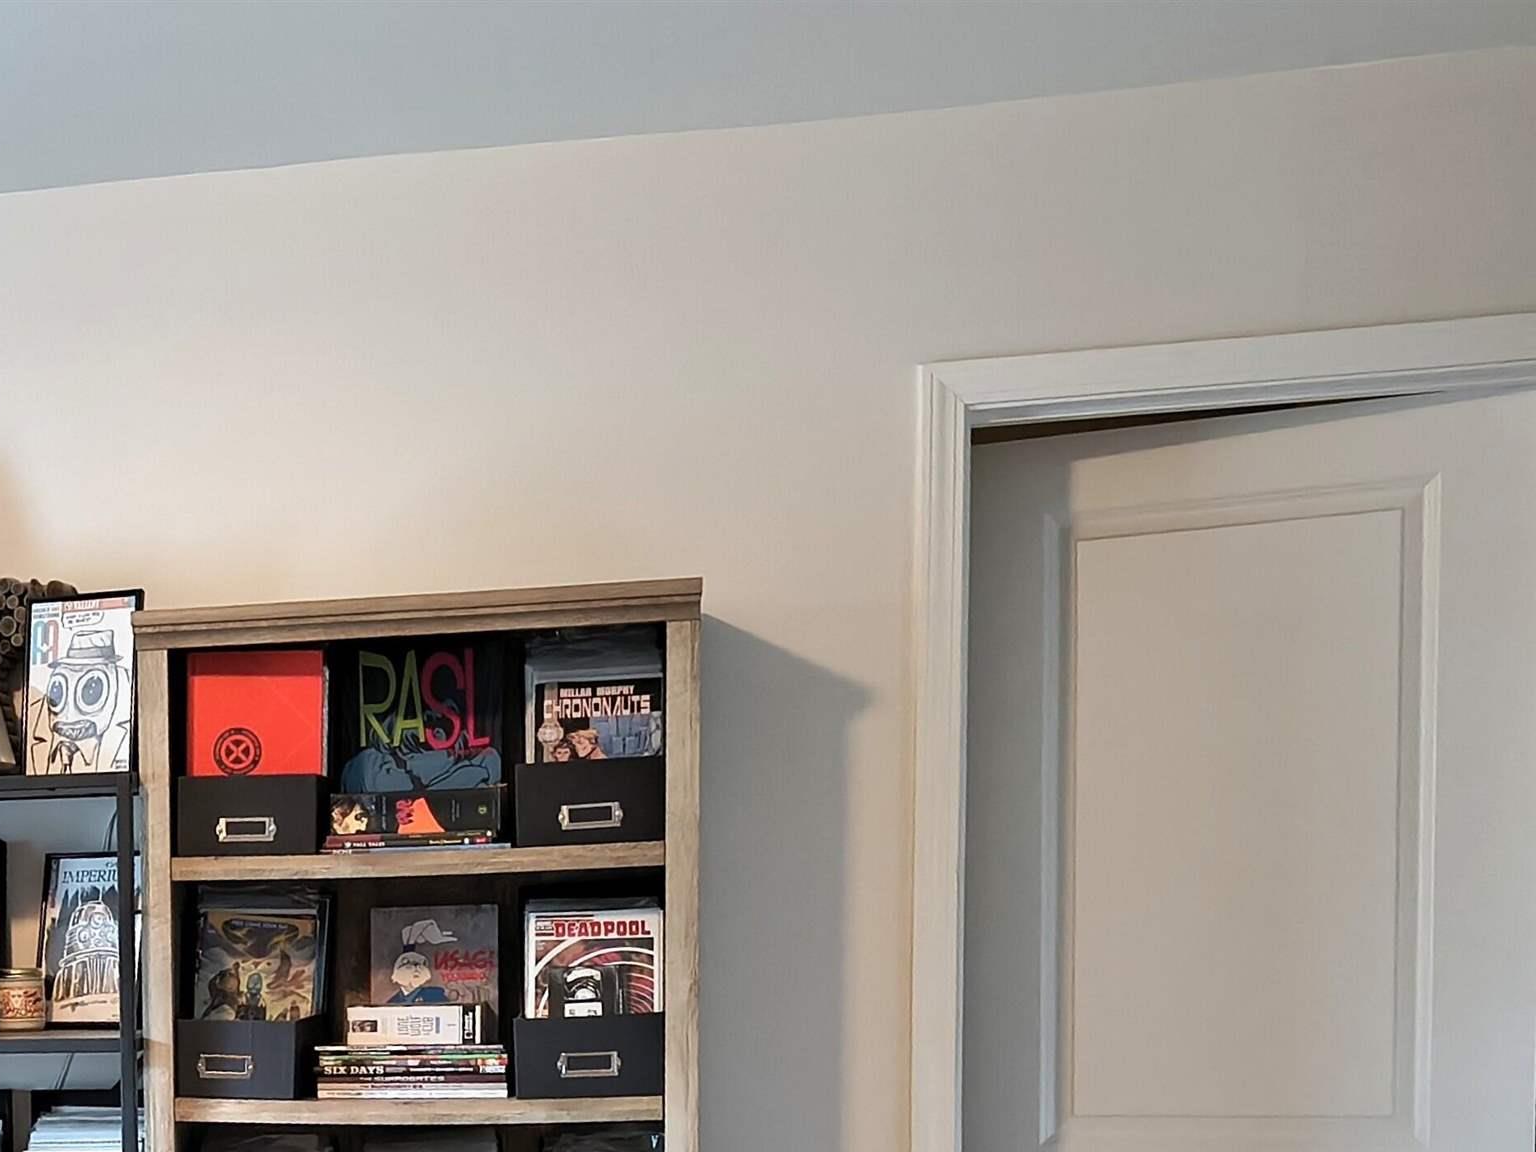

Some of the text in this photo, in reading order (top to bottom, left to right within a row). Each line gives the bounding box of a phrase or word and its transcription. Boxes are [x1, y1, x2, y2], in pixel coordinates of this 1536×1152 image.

[359, 648, 490, 751] RASL
[544, 695, 651, 719] CHRONONAUTS
[553, 919, 651, 938] DEADPOOL
[324, 1065, 384, 1075] SIX DAYS
